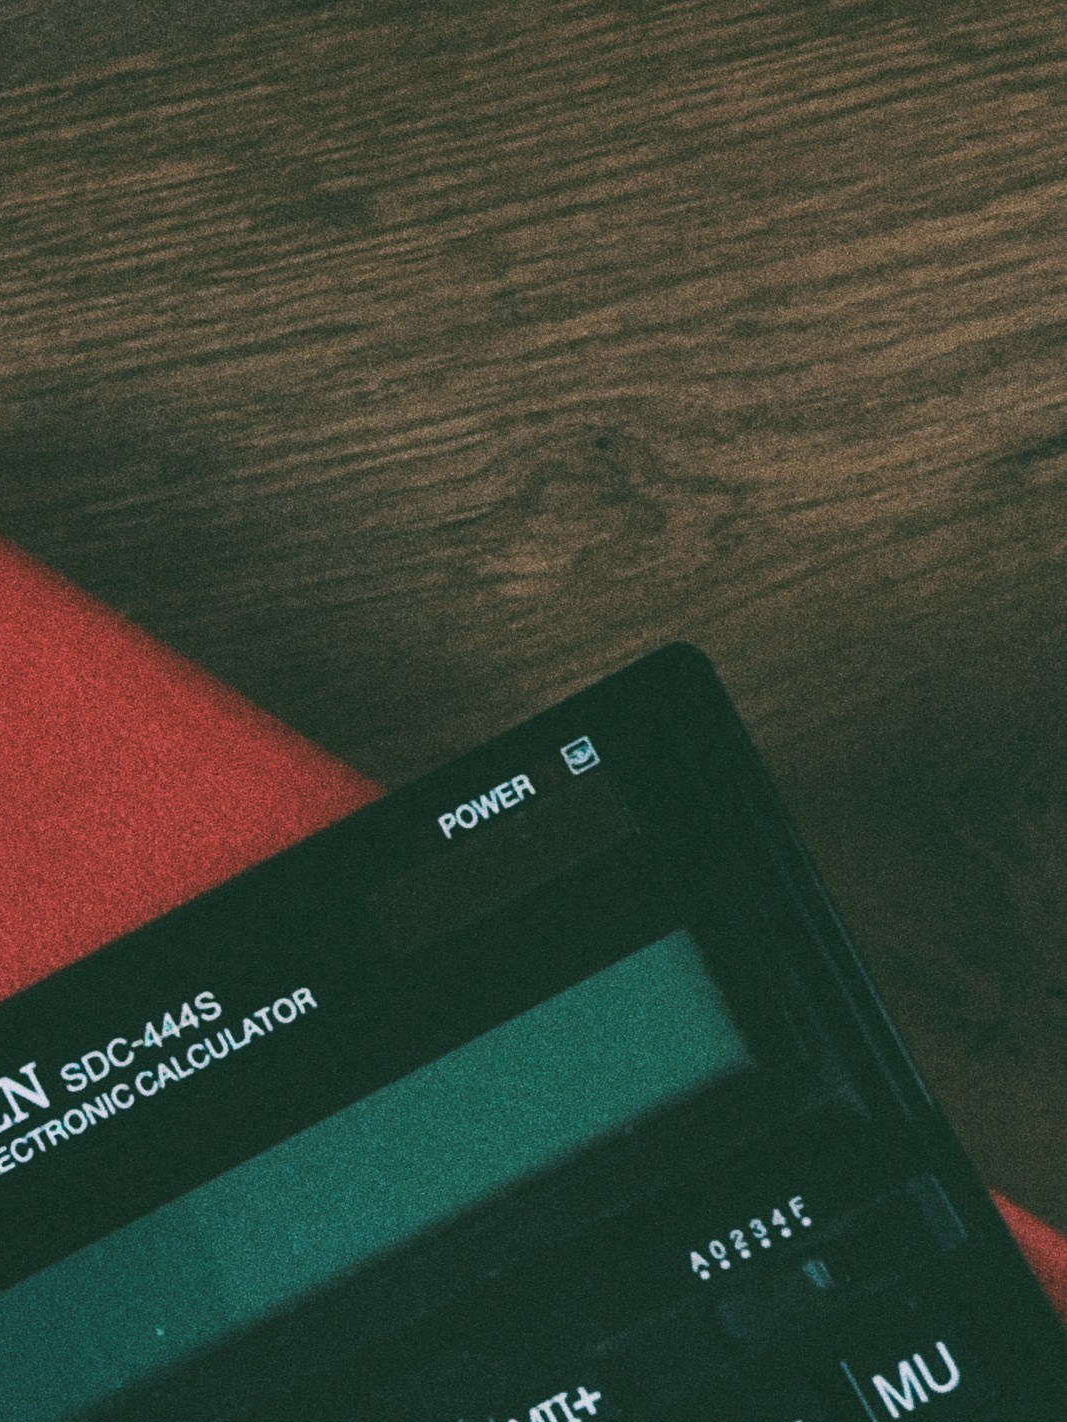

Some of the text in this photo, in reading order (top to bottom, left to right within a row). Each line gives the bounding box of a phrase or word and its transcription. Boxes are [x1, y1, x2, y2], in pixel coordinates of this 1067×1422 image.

[437, 774, 536, 839] POWER
[60, 991, 223, 1092] SDC-444S
[134, 987, 317, 1097] CALCULATOR
[872, 1341, 959, 1419] MU
